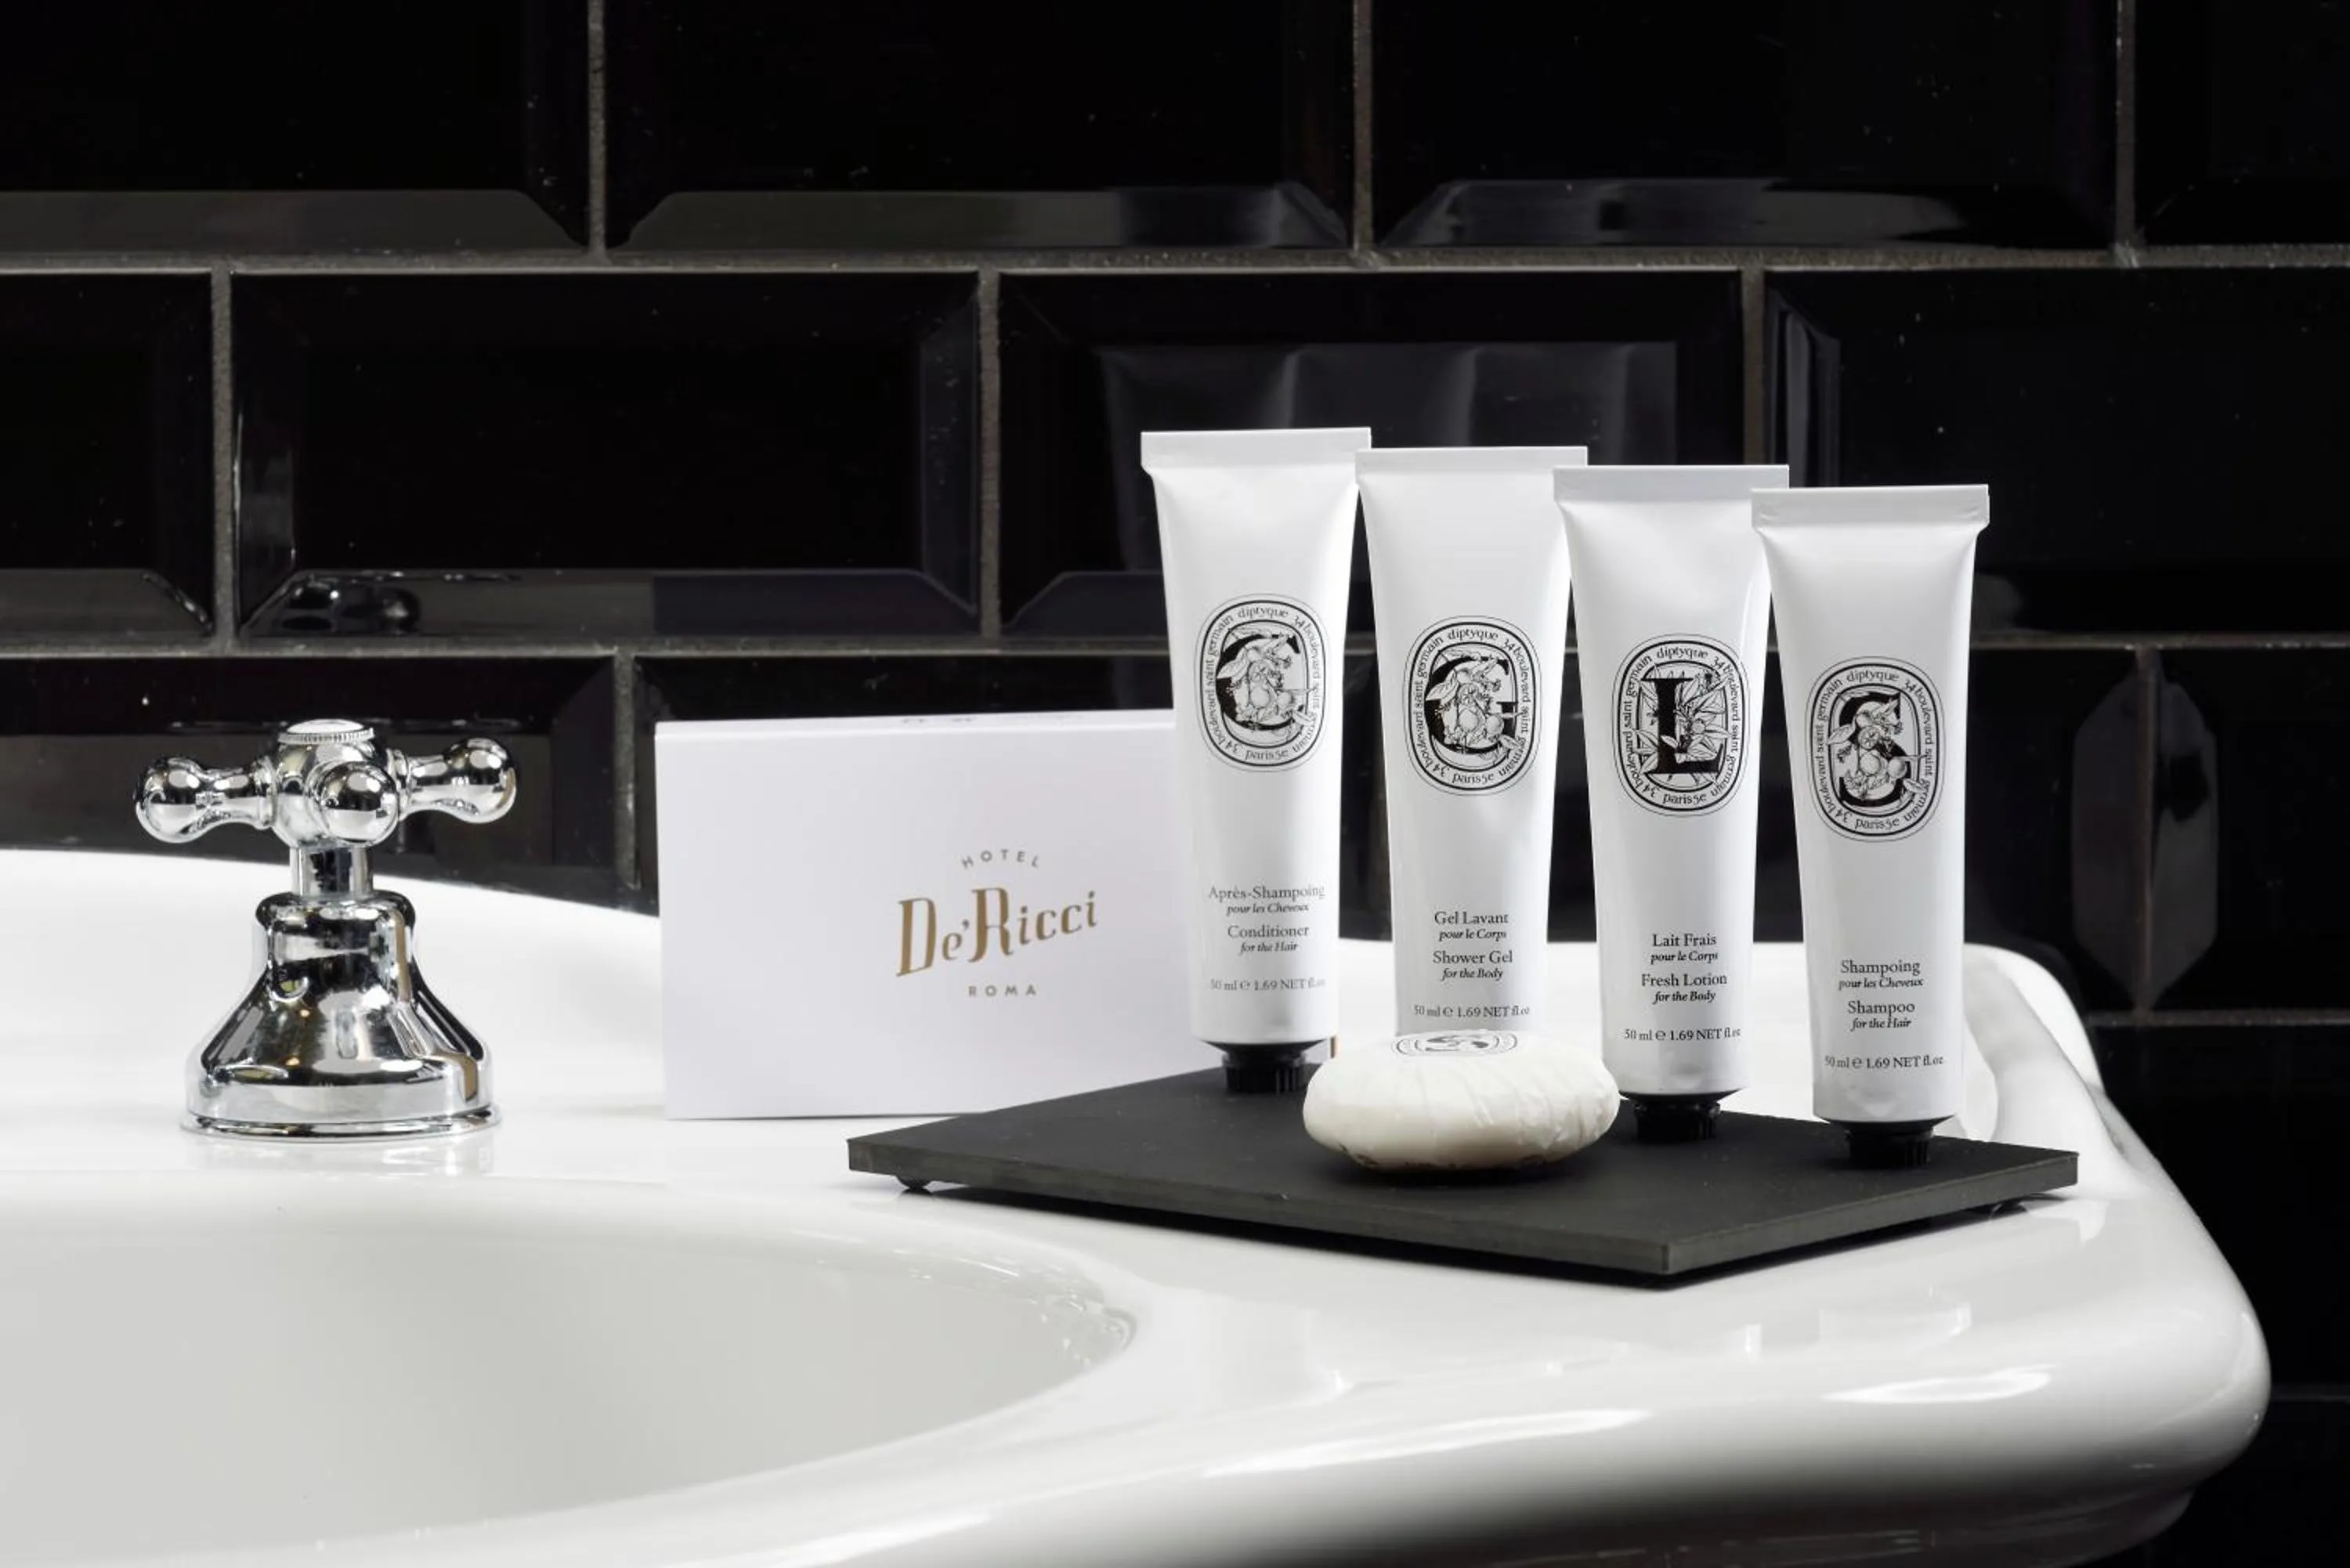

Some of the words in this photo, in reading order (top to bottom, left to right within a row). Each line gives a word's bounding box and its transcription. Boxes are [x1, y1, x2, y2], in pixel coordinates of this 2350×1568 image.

[1237, 606, 1289, 619] diptyque
[1448, 628, 1499, 641] diptyque
[1657, 646, 1708, 659] diptyque
[1846, 670, 1900, 683] diptyque
[961, 849, 1041, 869] HOTEL
[1208, 885, 1326, 902] Après-Shampoing
[1226, 905, 1249, 916] pour
[1434, 911, 1459, 924] Gel
[1462, 911, 1509, 924] Lavant
[1227, 924, 1310, 938] Conditioner
[1439, 930, 1463, 941] pour
[1466, 930, 1474, 939] le
[1477, 929, 1506, 941] Corps
[1653, 934, 1680, 947] Lait
[1683, 934, 1716, 947] Frais
[1239, 943, 1255, 956] for
[1257, 942, 1272, 952] the
[1274, 942, 1298, 952] Hair
[1433, 951, 1485, 964] Shower
[1489, 950, 1513, 963] Gel
[1650, 953, 1676, 964] pour
[1678, 952, 1687, 961] le
[1688, 951, 1718, 963] Corps
[1441, 968, 1457, 981] for
[1460, 969, 1475, 978] the
[1477, 968, 1503, 981] Body
[1840, 959, 1921, 977] Shampoing
[1224, 980, 1237, 991] ml
[1254, 979, 1278, 991] 1.69
[1280, 978, 1306, 989] NET
[1641, 974, 1679, 987] Fresh
[1683, 973, 1727, 986] Lotion
[1838, 980, 1863, 990] pour
[1864, 978, 1876, 988] les
[1879, 977, 1923, 988] Cheveux
[968, 985, 1037, 998] ROMA
[1653, 992, 1670, 1005] for
[1672, 992, 1688, 1001] the
[1690, 991, 1716, 1003] Body
[1457, 1006, 1481, 1018] 1.69
[1483, 1006, 1510, 1017] NET
[1848, 1000, 1915, 1017] Shampoo
[1850, 1018, 1867, 1031] for
[1869, 1018, 1885, 1028] the
[1887, 1017, 1911, 1028] Hair
[1639, 1031, 1652, 1041] ml
[1670, 1030, 1694, 1041] 1.69
[1696, 1029, 1722, 1041] NET
[1837, 1057, 1849, 1068] ml
[1866, 1057, 1890, 1069] 1.69
[1893, 1057, 1922, 1068] NET
